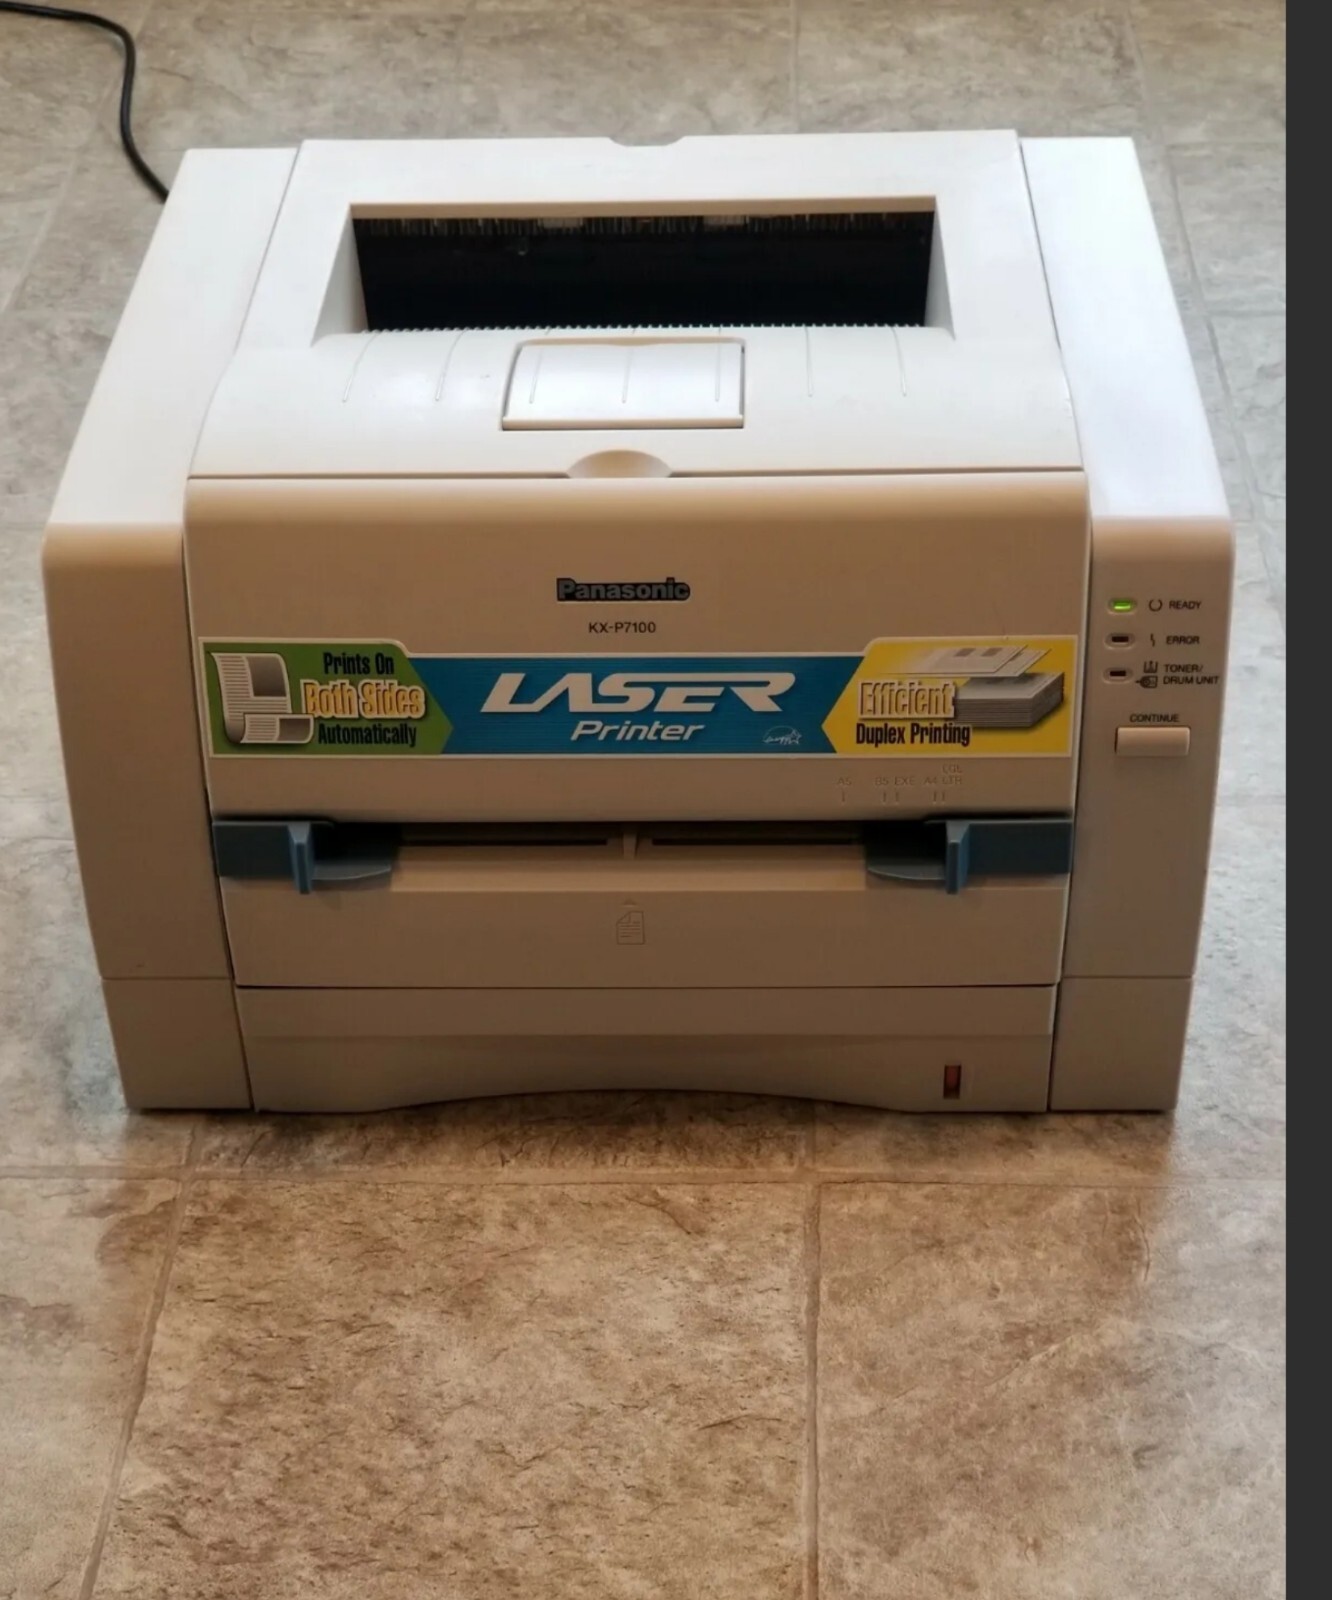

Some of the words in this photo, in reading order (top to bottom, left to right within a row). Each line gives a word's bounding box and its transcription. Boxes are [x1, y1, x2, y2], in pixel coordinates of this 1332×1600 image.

[556, 577, 691, 601] Panasonic
[1168, 600, 1202, 610] READY
[588, 621, 657, 634] KX-P7100
[1165, 635, 1201, 645] ERROR
[323, 652, 371, 675] Prints
[375, 652, 395, 675] On
[1164, 664, 1204, 673] TONER/
[1162, 676, 1194, 685] DRUM
[1196, 676, 1219, 685] UNIT
[302, 681, 358, 718] Both
[359, 680, 425, 719] Sides
[480, 672, 796, 713] LASER
[859, 680, 955, 717] Efficient
[1129, 713, 1180, 723] CONTINUE
[318, 722, 417, 748] Automatically
[570, 719, 706, 742] Printer
[855, 722, 905, 747] Duplex
[910, 722, 971, 746] Printing
